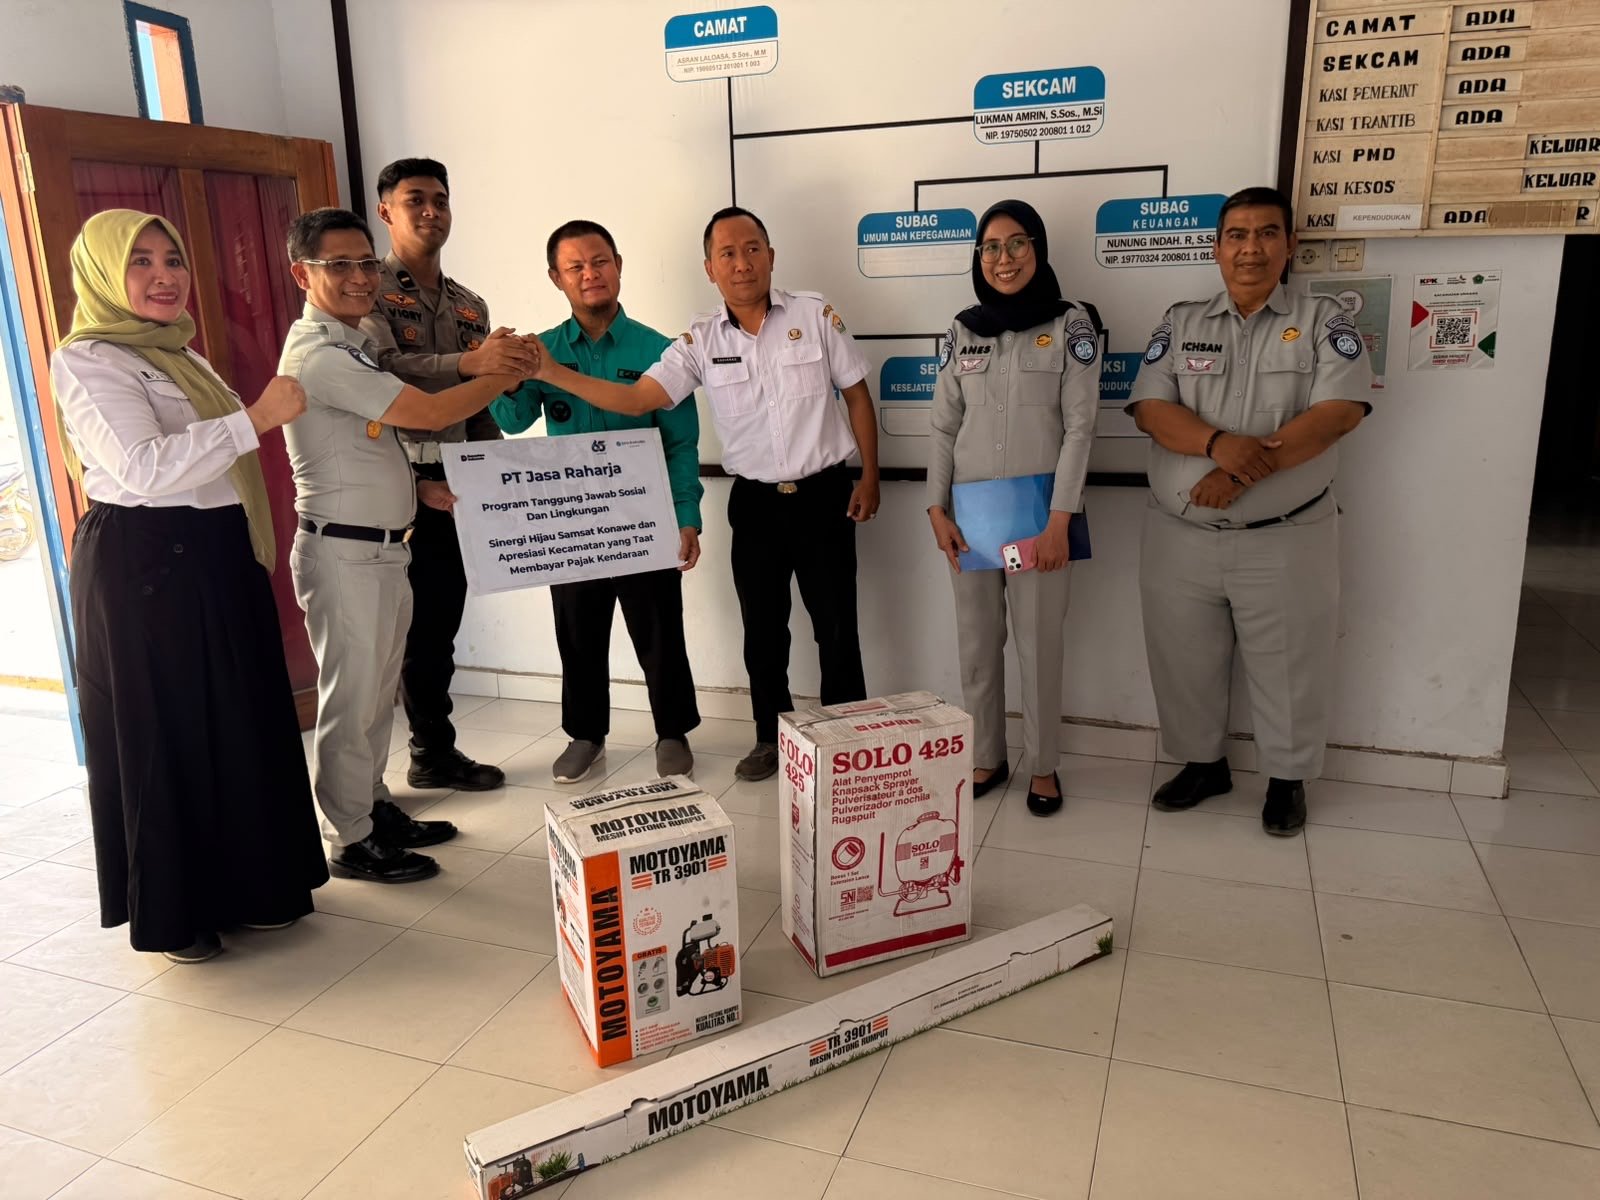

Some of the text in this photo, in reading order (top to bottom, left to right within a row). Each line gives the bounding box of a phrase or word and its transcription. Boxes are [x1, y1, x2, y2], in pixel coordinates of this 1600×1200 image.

[1326, 14, 1415, 37] CAMAT
[1465, 9, 1515, 26] ADA
[694, 16, 747, 38] CAMAT
[1323, 50, 1418, 72] SEKCAM
[1462, 45, 1511, 61] ADA
[1002, 76, 1076, 98] SEKCAM
[1319, 83, 1418, 102] KASI PEMERINT
[1458, 78, 1506, 94] ADA
[976, 112, 1013, 124] LUKMAN
[1015, 110, 1048, 122] AMRIN,
[1083, 106, 1102, 116] M.Si
[1316, 114, 1416, 132] KASI TRANTIB
[1455, 109, 1503, 125] ADA
[986, 124, 1091, 140] NIP. 19750502 200801 1 012
[1529, 137, 1600, 154] KELUAR
[1313, 147, 1395, 164] KASI PMD
[1310, 180, 1395, 196] KASI KESOS
[1524, 172, 1596, 188] KELUAR
[1140, 200, 1189, 215] SUBAG
[896, 214, 938, 228] SUBAG
[1133, 217, 1198, 229] KEUANGAN
[1307, 213, 1335, 228] KASI
[1352, 213, 1411, 222] KEPENDUDUKAN
[1444, 210, 1486, 224] ADA
[863, 229, 972, 243] UMUM DAN KEPEGAWAIAN
[1107, 238, 1147, 248] NUNUNG
[1150, 236, 1182, 246] INDAH.
[1105, 252, 1215, 264] NIP. 19770324 200801 1 013
[1182, 342, 1222, 353] ICHSAN
[591, 440, 606, 452] 65
[501, 463, 622, 485] PT Jasa Raharja
[482, 486, 646, 512] Program Tanggung Jawab Sosial
[526, 505, 610, 521] Dan Lingkungan
[488, 520, 656, 548] Sinergi Hijau Samsat Konawe dan
[498, 534, 654, 562] Apresiasi Kecamatan yang Taat
[510, 549, 649, 575] Membayar Pajak Kendaraan
[780, 732, 813, 776] SOLO
[832, 734, 964, 775] SOLO 425
[785, 762, 804, 792] 425
[832, 768, 912, 787] Alat Penyemprot
[832, 777, 919, 796] Knapsack Sprayer
[907, 785, 923, 794] dos
[832, 793, 930, 815] Pulverizador mochila
[590, 804, 702, 835] MOTOYAMA
[832, 811, 876, 824] Rugspuit
[596, 815, 706, 842] MESIN POTONG RUMPUT
[630, 836, 726, 874] MOTOYAMA
[912, 840, 940, 853] SOLO
[653, 859, 707, 884] TR 3901
[841, 891, 856, 903] SNI
[637, 947, 662, 958] GRATIS
[591, 886, 628, 1042] MOTOYAMA
[696, 1015, 725, 1032] KUALITAS
[827, 1022, 872, 1050] TR 3901
[810, 1028, 888, 1067] MESIN POTONG RUMPUT
[648, 1066, 770, 1136] MOTOYAMA
